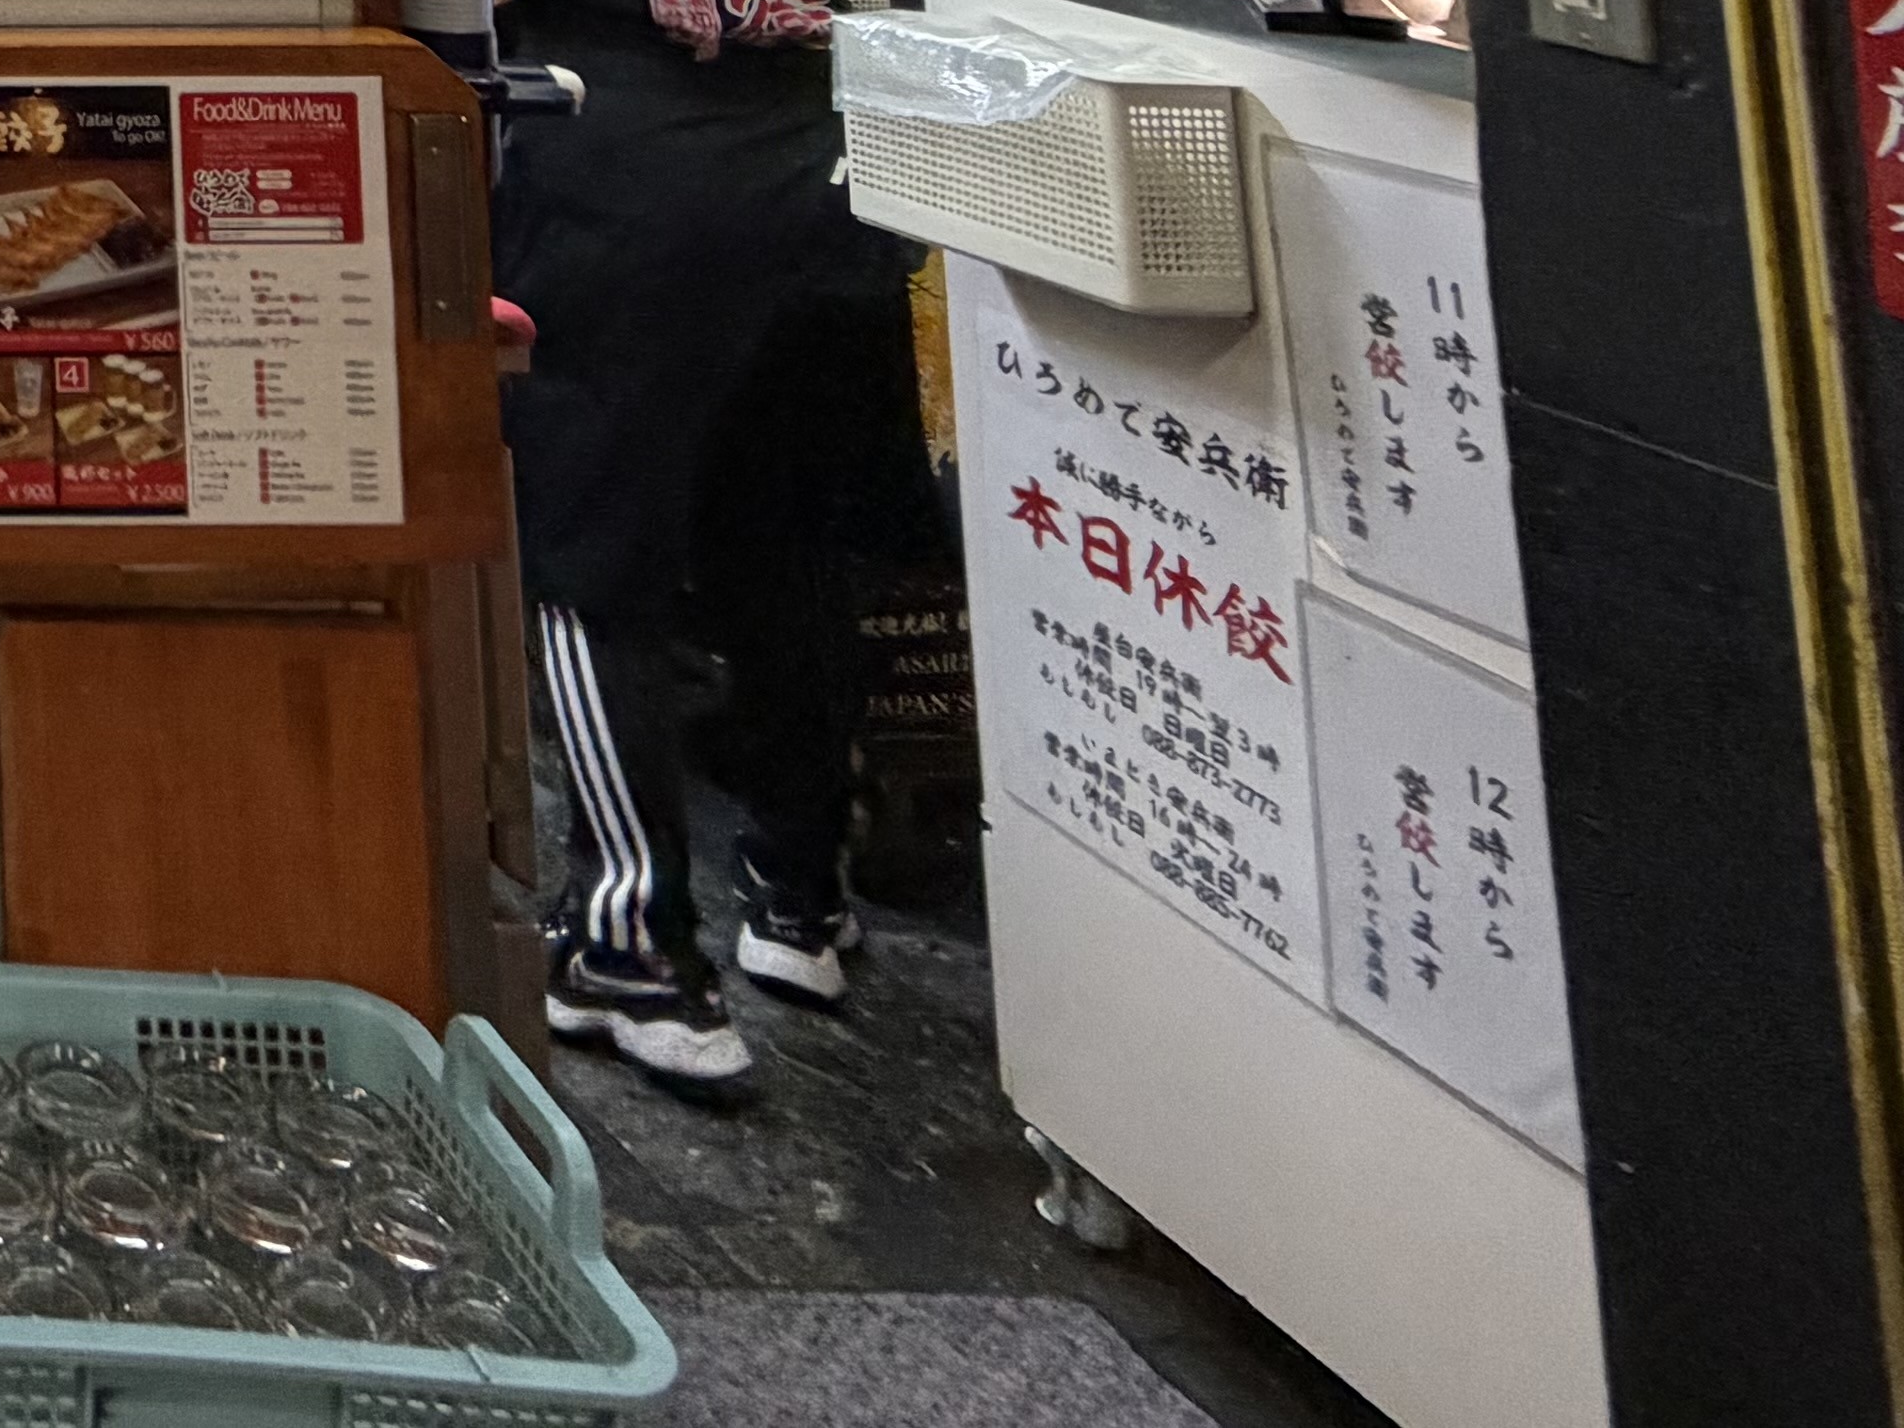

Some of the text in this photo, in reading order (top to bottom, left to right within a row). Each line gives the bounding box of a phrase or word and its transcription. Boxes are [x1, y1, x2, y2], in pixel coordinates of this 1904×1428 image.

[996, 341, 1289, 510] ひろめで安兵衛
[1360, 292, 1417, 517] 営餃します
[1426, 275, 1485, 463] 11時から
[1007, 475, 1295, 686] 本日休餃
[1393, 764, 1444, 991] 営餃します
[1467, 764, 1515, 962] 12時から
